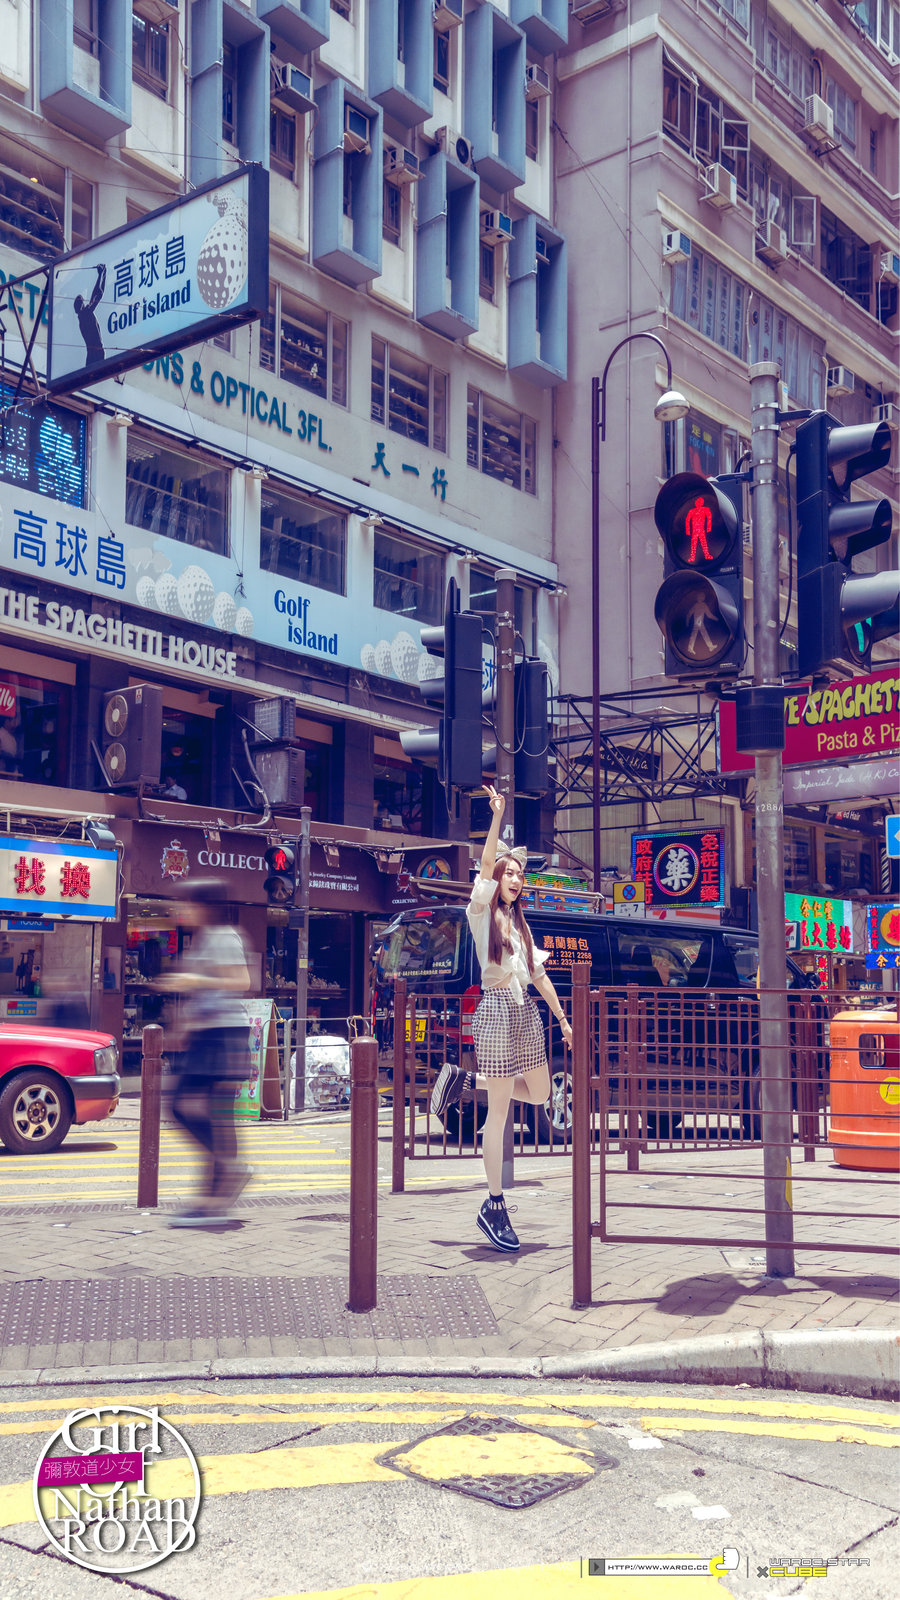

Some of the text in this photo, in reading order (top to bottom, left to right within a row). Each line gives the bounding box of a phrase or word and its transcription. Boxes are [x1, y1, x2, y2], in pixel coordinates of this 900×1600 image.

[114, 235, 186, 303] 高球島
[107, 279, 191, 334] Golf island
[190, 361, 205, 396] &
[210, 370, 293, 435] OPTICAL
[297, 409, 332, 451] 3FL.
[13, 508, 126, 590] 高球島
[274, 589, 311, 623] Golf
[0, 588, 237, 676] THE SPAGHETTI HOUSE
[287, 600, 338, 656] island
[0, 687, 15, 712] lly
[817, 730, 858, 752] Pasta
[862, 725, 876, 746] &
[14, 855, 91, 899] 找換
[197, 850, 269, 871] COLLECT
[660, 848, 693, 891] 藥
[700, 834, 720, 902] 免稅正藥
[632, 904, 639, 913] 7
[543, 935, 589, 951] 嘉蘭麵包
[560, 950, 575, 959] 2321
